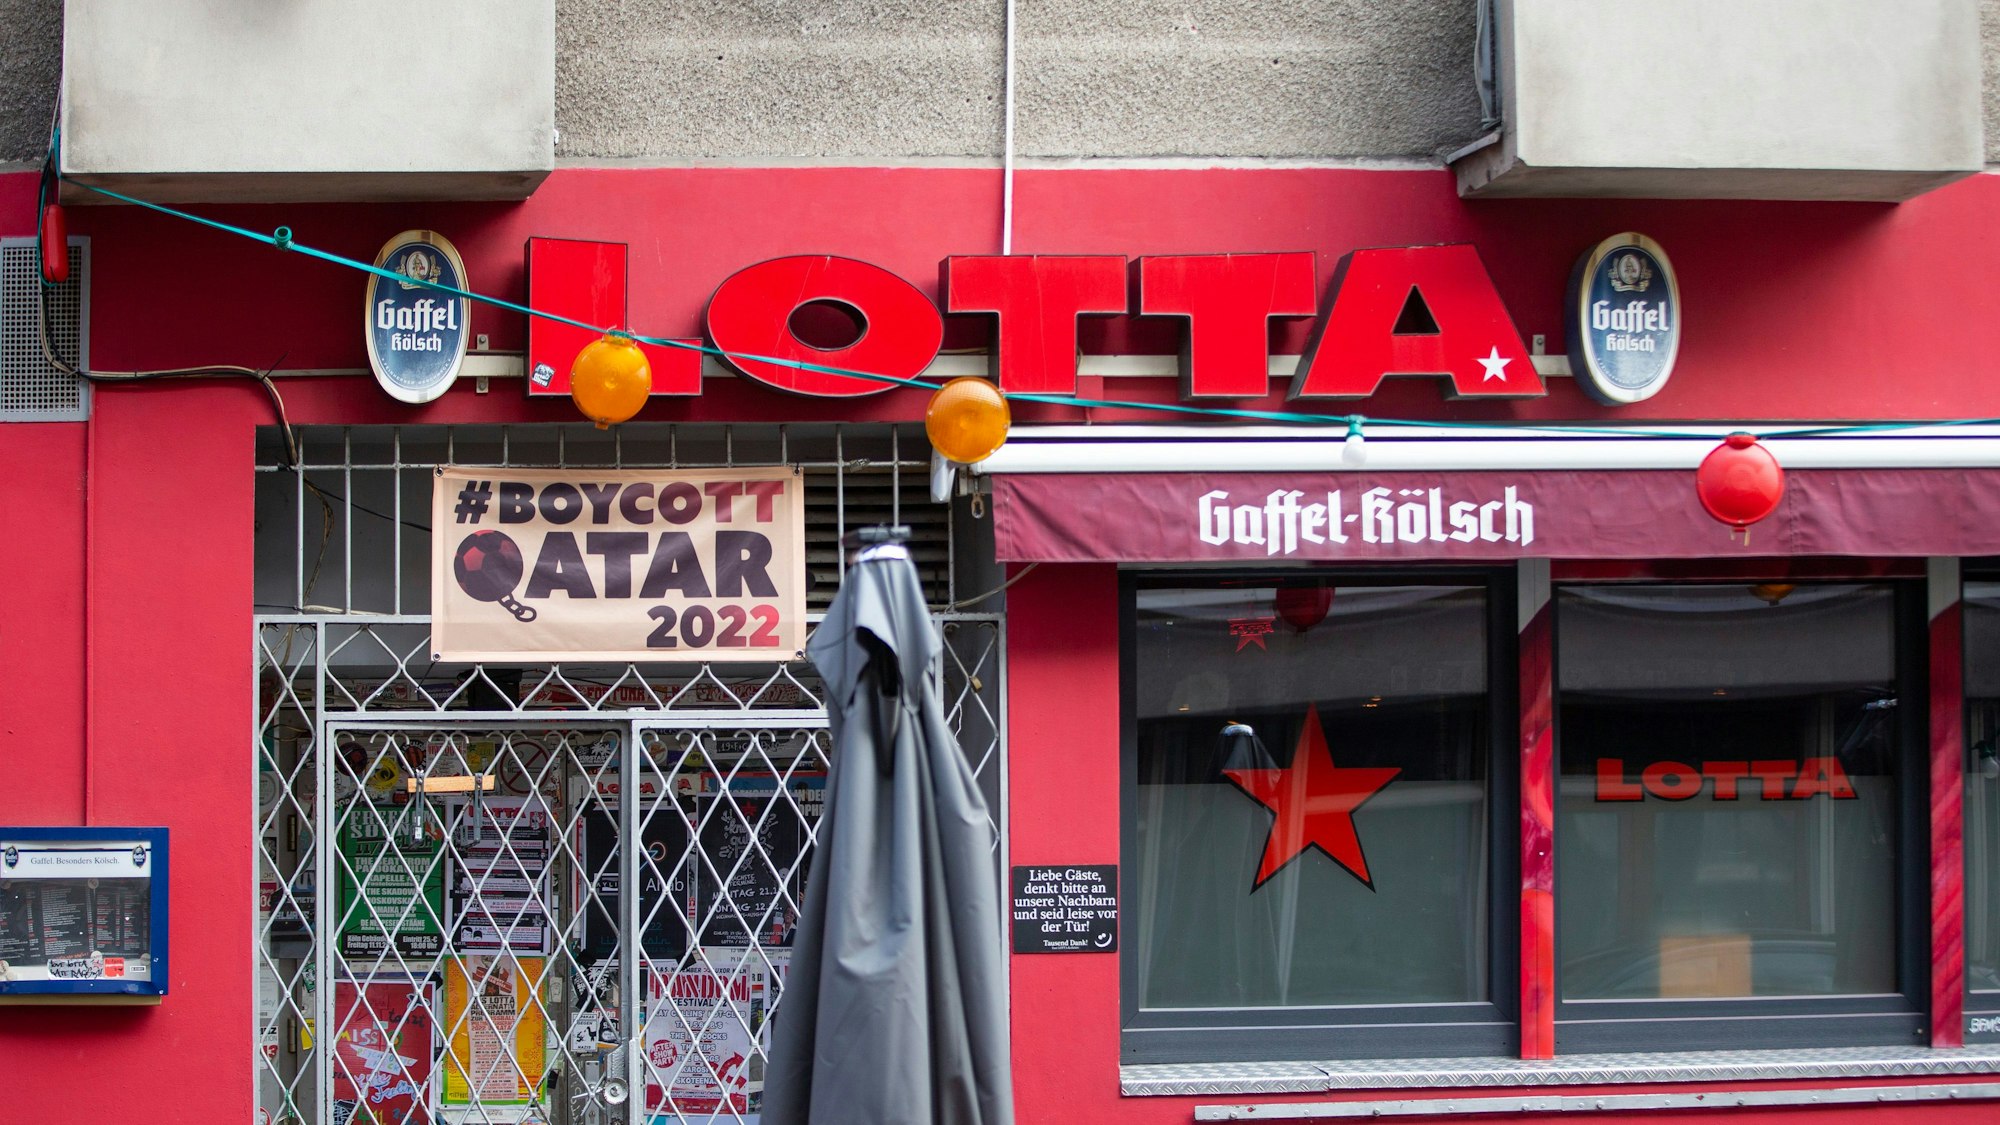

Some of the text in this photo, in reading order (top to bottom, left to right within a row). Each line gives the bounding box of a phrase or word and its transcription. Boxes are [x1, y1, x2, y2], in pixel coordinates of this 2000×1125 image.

[378, 298, 458, 333] Gaffel
[525, 237, 1548, 400] LOTTA
[1592, 300, 1669, 333] Gaffel
[391, 333, 442, 352] Kölsch
[1606, 333, 1655, 353] Kölsch
[454, 480, 784, 525] #BOYCOTT
[1198, 485, 1535, 556] Gaffel-Kölsch
[453, 529, 779, 622] QATAR
[646, 604, 780, 648] 2022
[1594, 756, 1860, 802] LOTTA
[597, 781, 656, 794] LOA
[350, 811, 437, 826] FREEDM
[30, 857, 55, 865] Gaffel.
[56, 857, 92, 865] Besonders
[356, 864, 431, 873] PAOOKAILLE
[1029, 869, 1102, 882] Liebe Gäste,
[381, 888, 420, 896] SKADOW
[1024, 882, 1107, 894] denkt bitte an
[363, 897, 422, 905] OSKOVSKAA
[1014, 895, 1116, 907] unsere Nachbarn
[1014, 908, 1117, 920] und seid leise vor
[1041, 920, 1090, 932] der Tür!
[654, 974, 748, 1002] RANDOM
[673, 998, 714, 1007] FESTIVAL
[670, 1032, 686, 1040] THE
[652, 1056, 677, 1067] PARTY
[653, 1051, 673, 1060] SHOW
